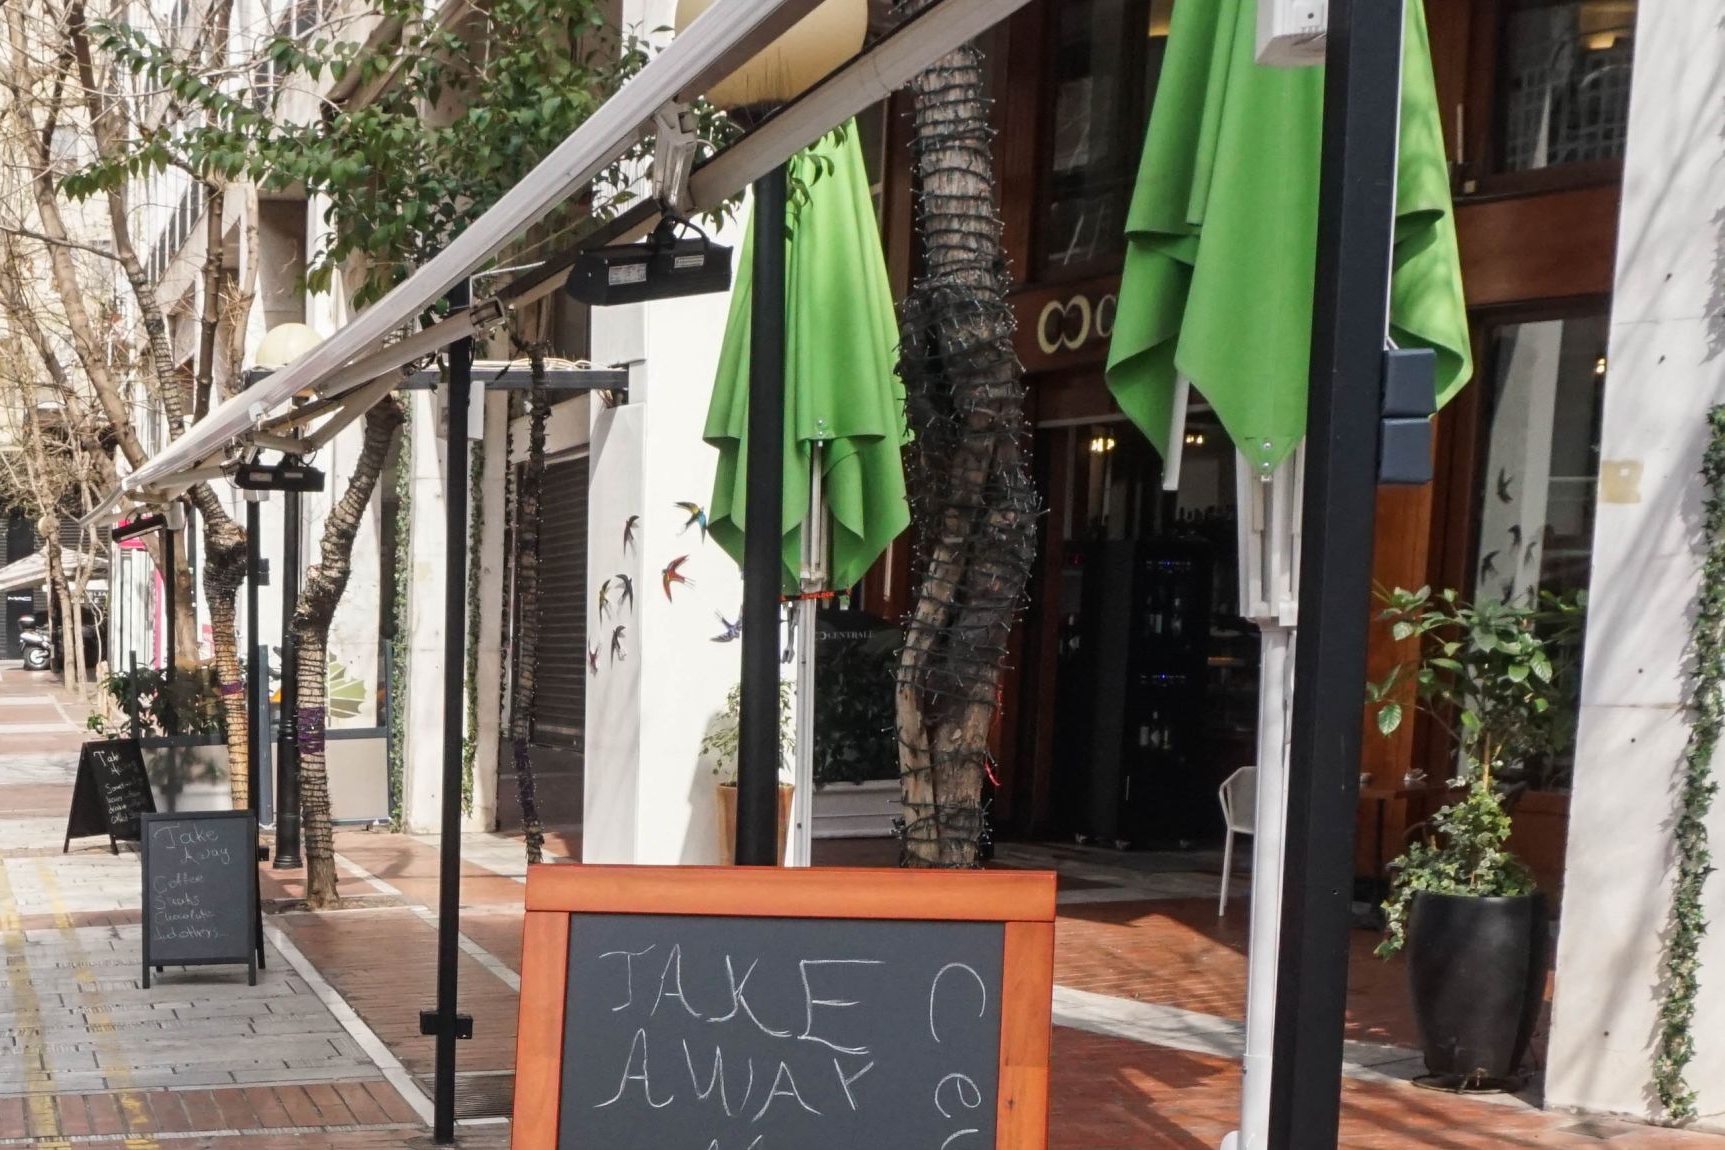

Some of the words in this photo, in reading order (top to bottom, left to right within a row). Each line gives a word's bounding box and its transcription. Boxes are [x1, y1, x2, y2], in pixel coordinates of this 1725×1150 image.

[154, 822, 218, 849] Take
[597, 942, 886, 1055] TAKE
[593, 1027, 874, 1122] AWAY
